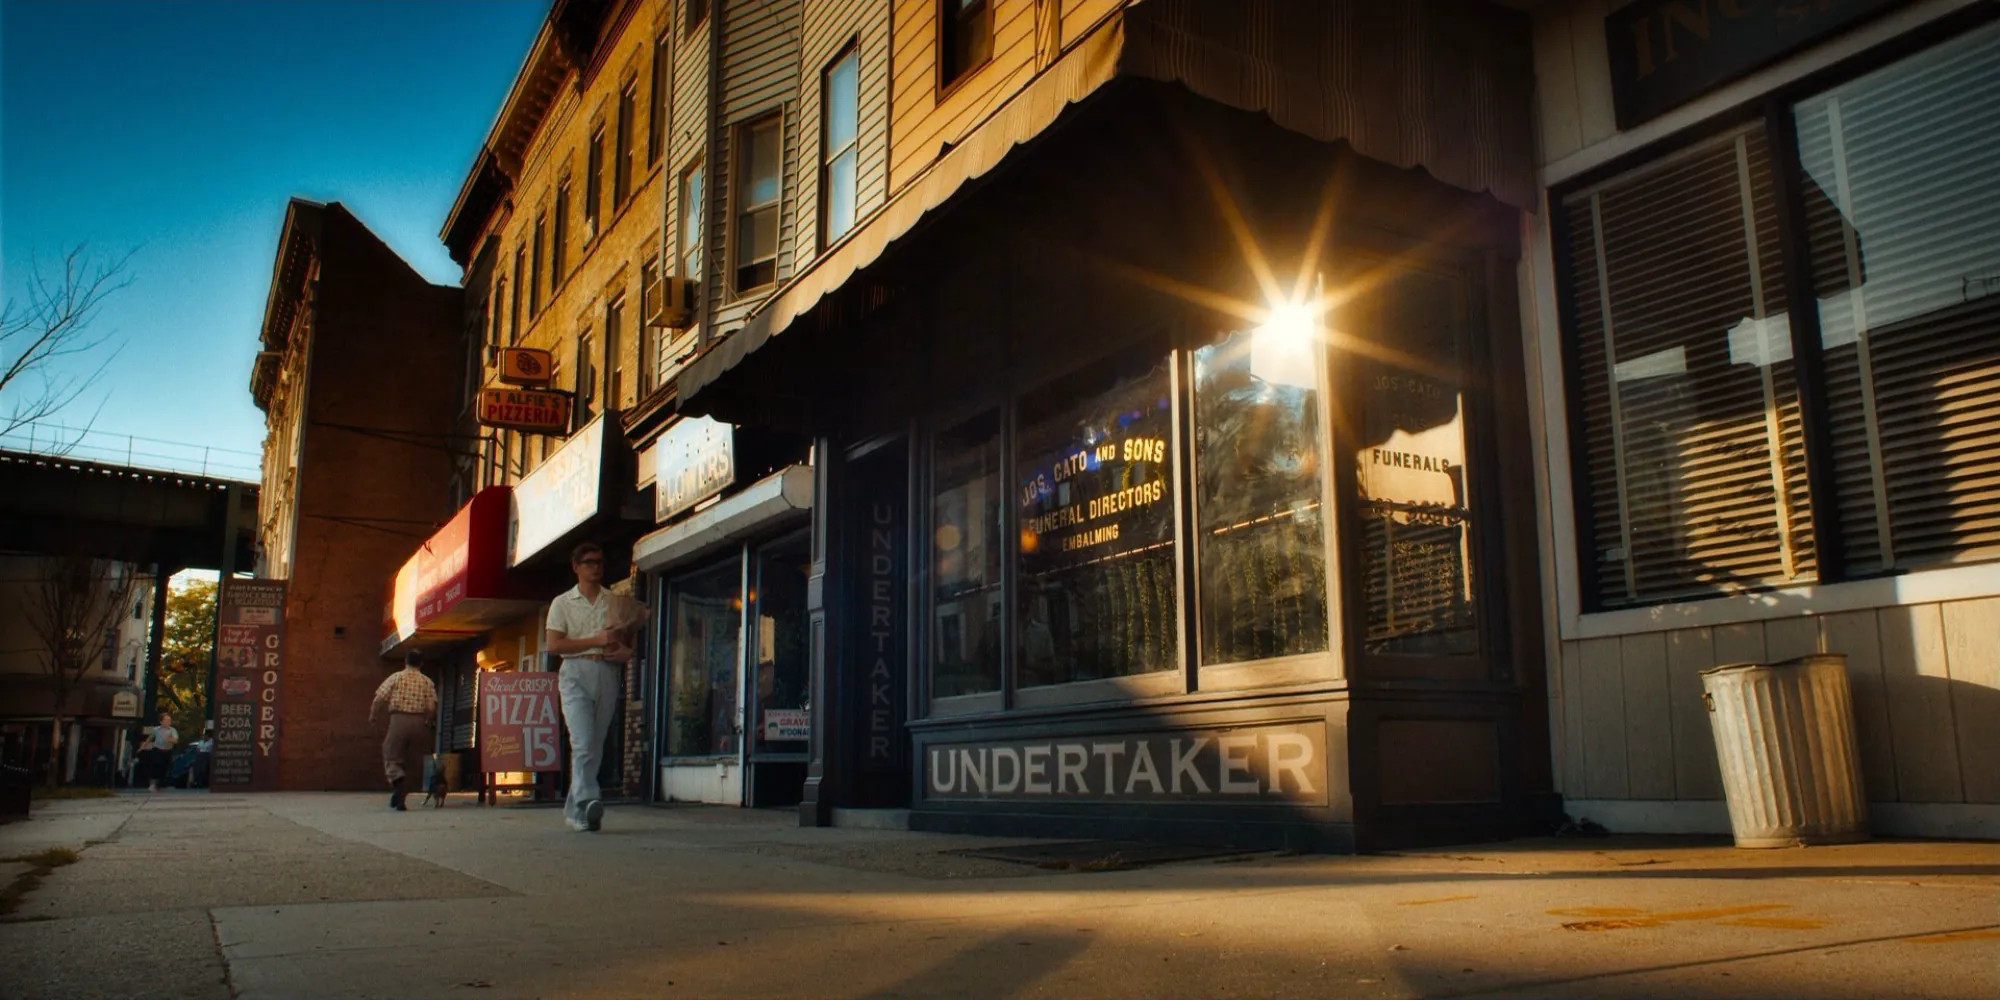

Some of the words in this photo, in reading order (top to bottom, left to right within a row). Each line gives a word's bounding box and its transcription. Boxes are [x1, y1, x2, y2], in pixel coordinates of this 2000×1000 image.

[1633, 0, 1752, 83] IN
[488, 404, 559, 424] PIZZERIA
[1053, 450, 1088, 482] CATO
[1094, 444, 1116, 463] AND
[1123, 438, 1165, 463] SONS
[1373, 449, 1450, 474] FUNERALS
[1028, 505, 1085, 534] FUNERAL
[1089, 480, 1161, 520] DIRECTORS
[1062, 523, 1119, 552] EMBALMING
[870, 503, 892, 758] UNDERTAKER
[258, 633, 279, 757] GROCERY
[519, 678, 554, 692] CRISPY
[221, 704, 252, 715] BEER
[221, 717, 251, 728] SODA
[486, 694, 556, 725] PIZZA
[218, 730, 252, 742] CANDY
[931, 735, 1317, 797] UNDERTAKER
